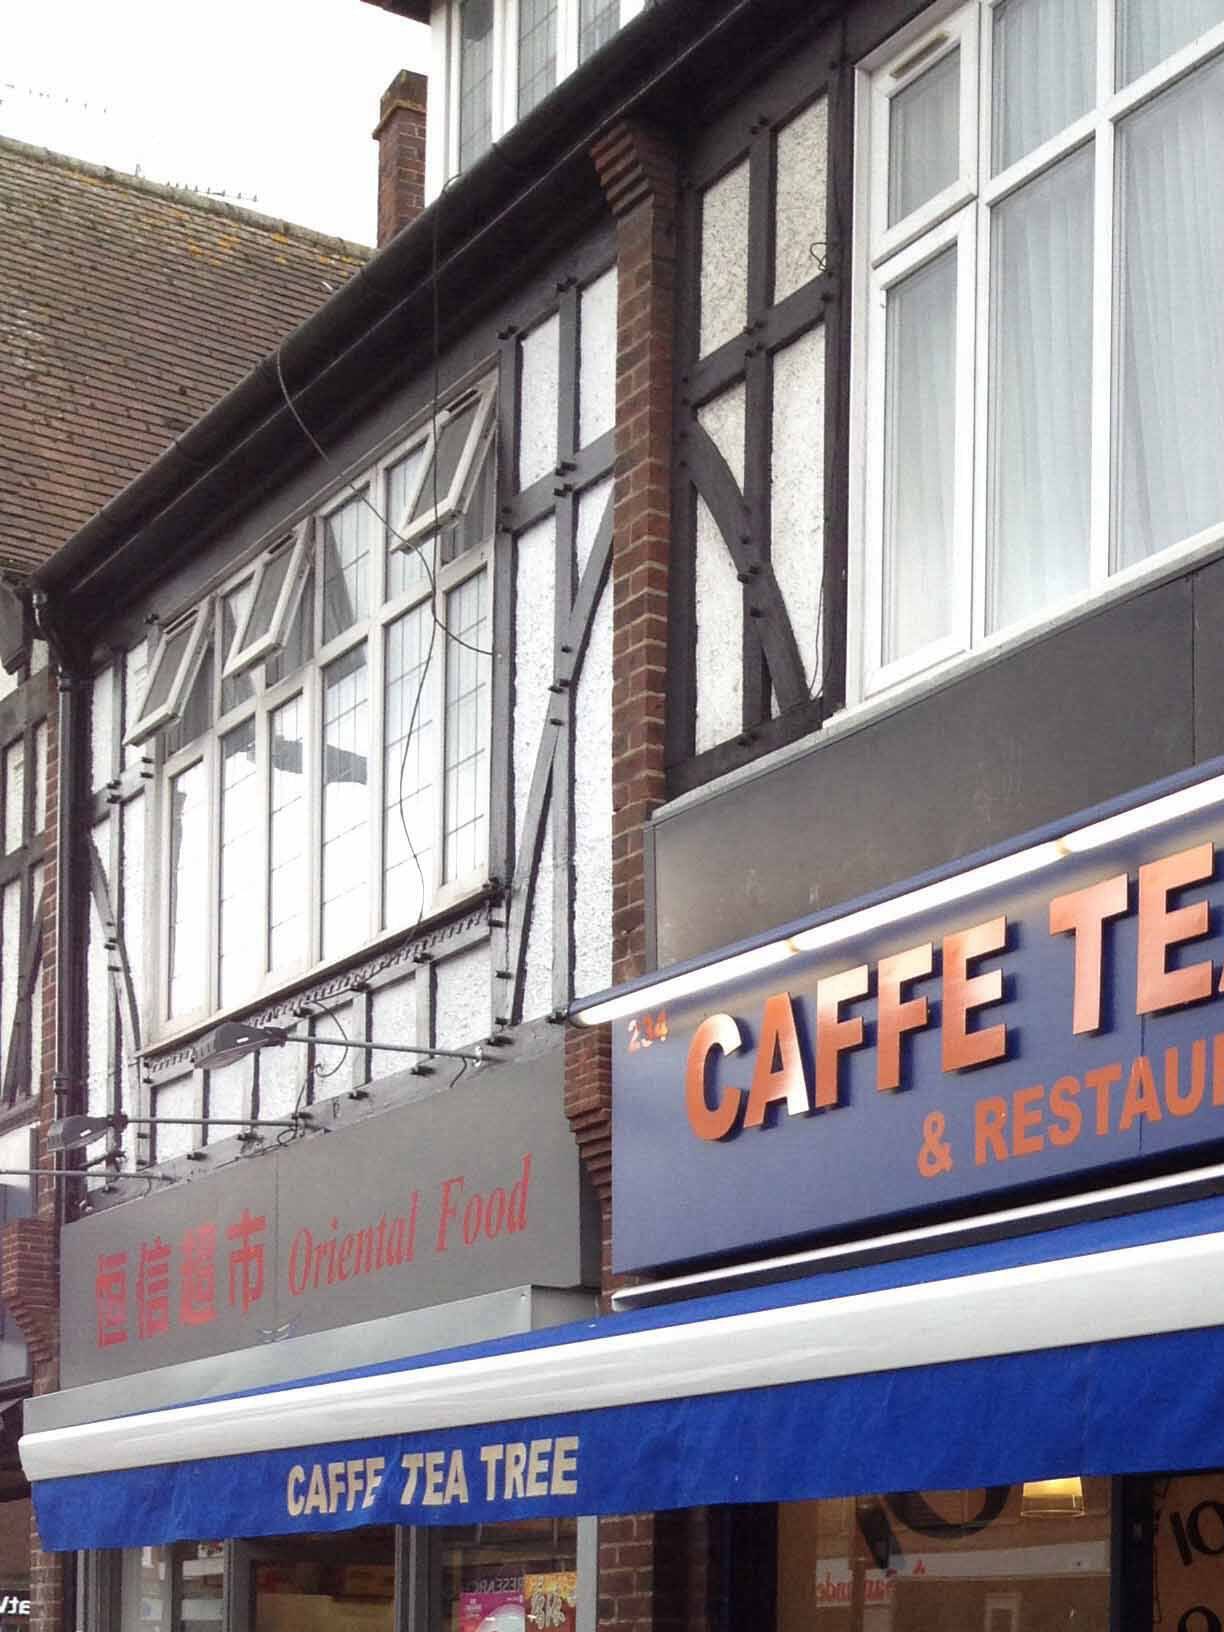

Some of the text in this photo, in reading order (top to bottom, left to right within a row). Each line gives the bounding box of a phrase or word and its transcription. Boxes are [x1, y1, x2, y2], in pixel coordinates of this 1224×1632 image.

[685, 915, 1007, 1142] CAFFE
[917, 1110, 953, 1179] &
[288, 1153, 532, 1297] Oriental Food
[287, 1435, 580, 1517] CAFFE TEA TREE
